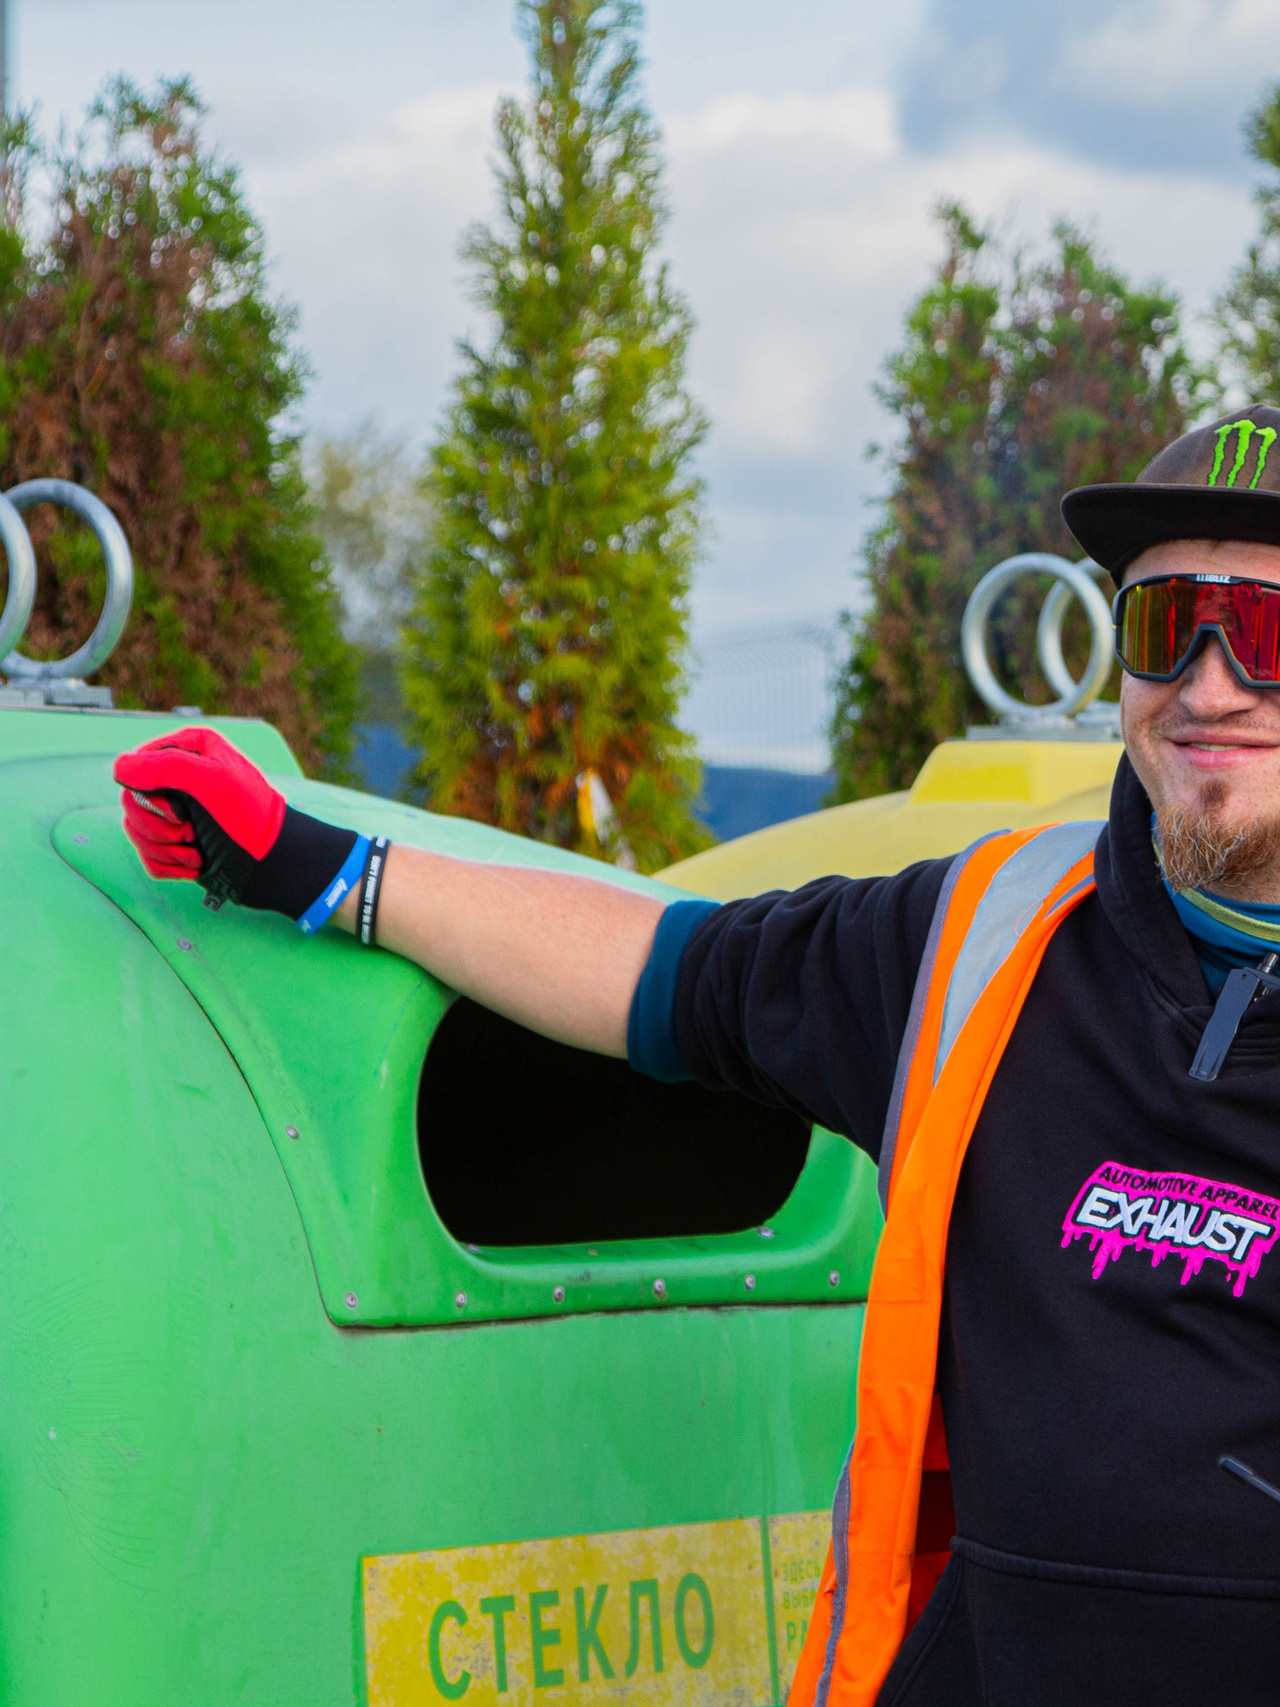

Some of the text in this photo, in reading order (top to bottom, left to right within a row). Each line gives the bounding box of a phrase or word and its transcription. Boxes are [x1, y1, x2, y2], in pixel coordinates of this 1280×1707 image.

[1076, 1187, 1271, 1261] EXHAUST
[1098, 1166, 1279, 1220] AUTOMOTIVE APPAREL
[428, 1573, 714, 1700] СТЕКЛО
